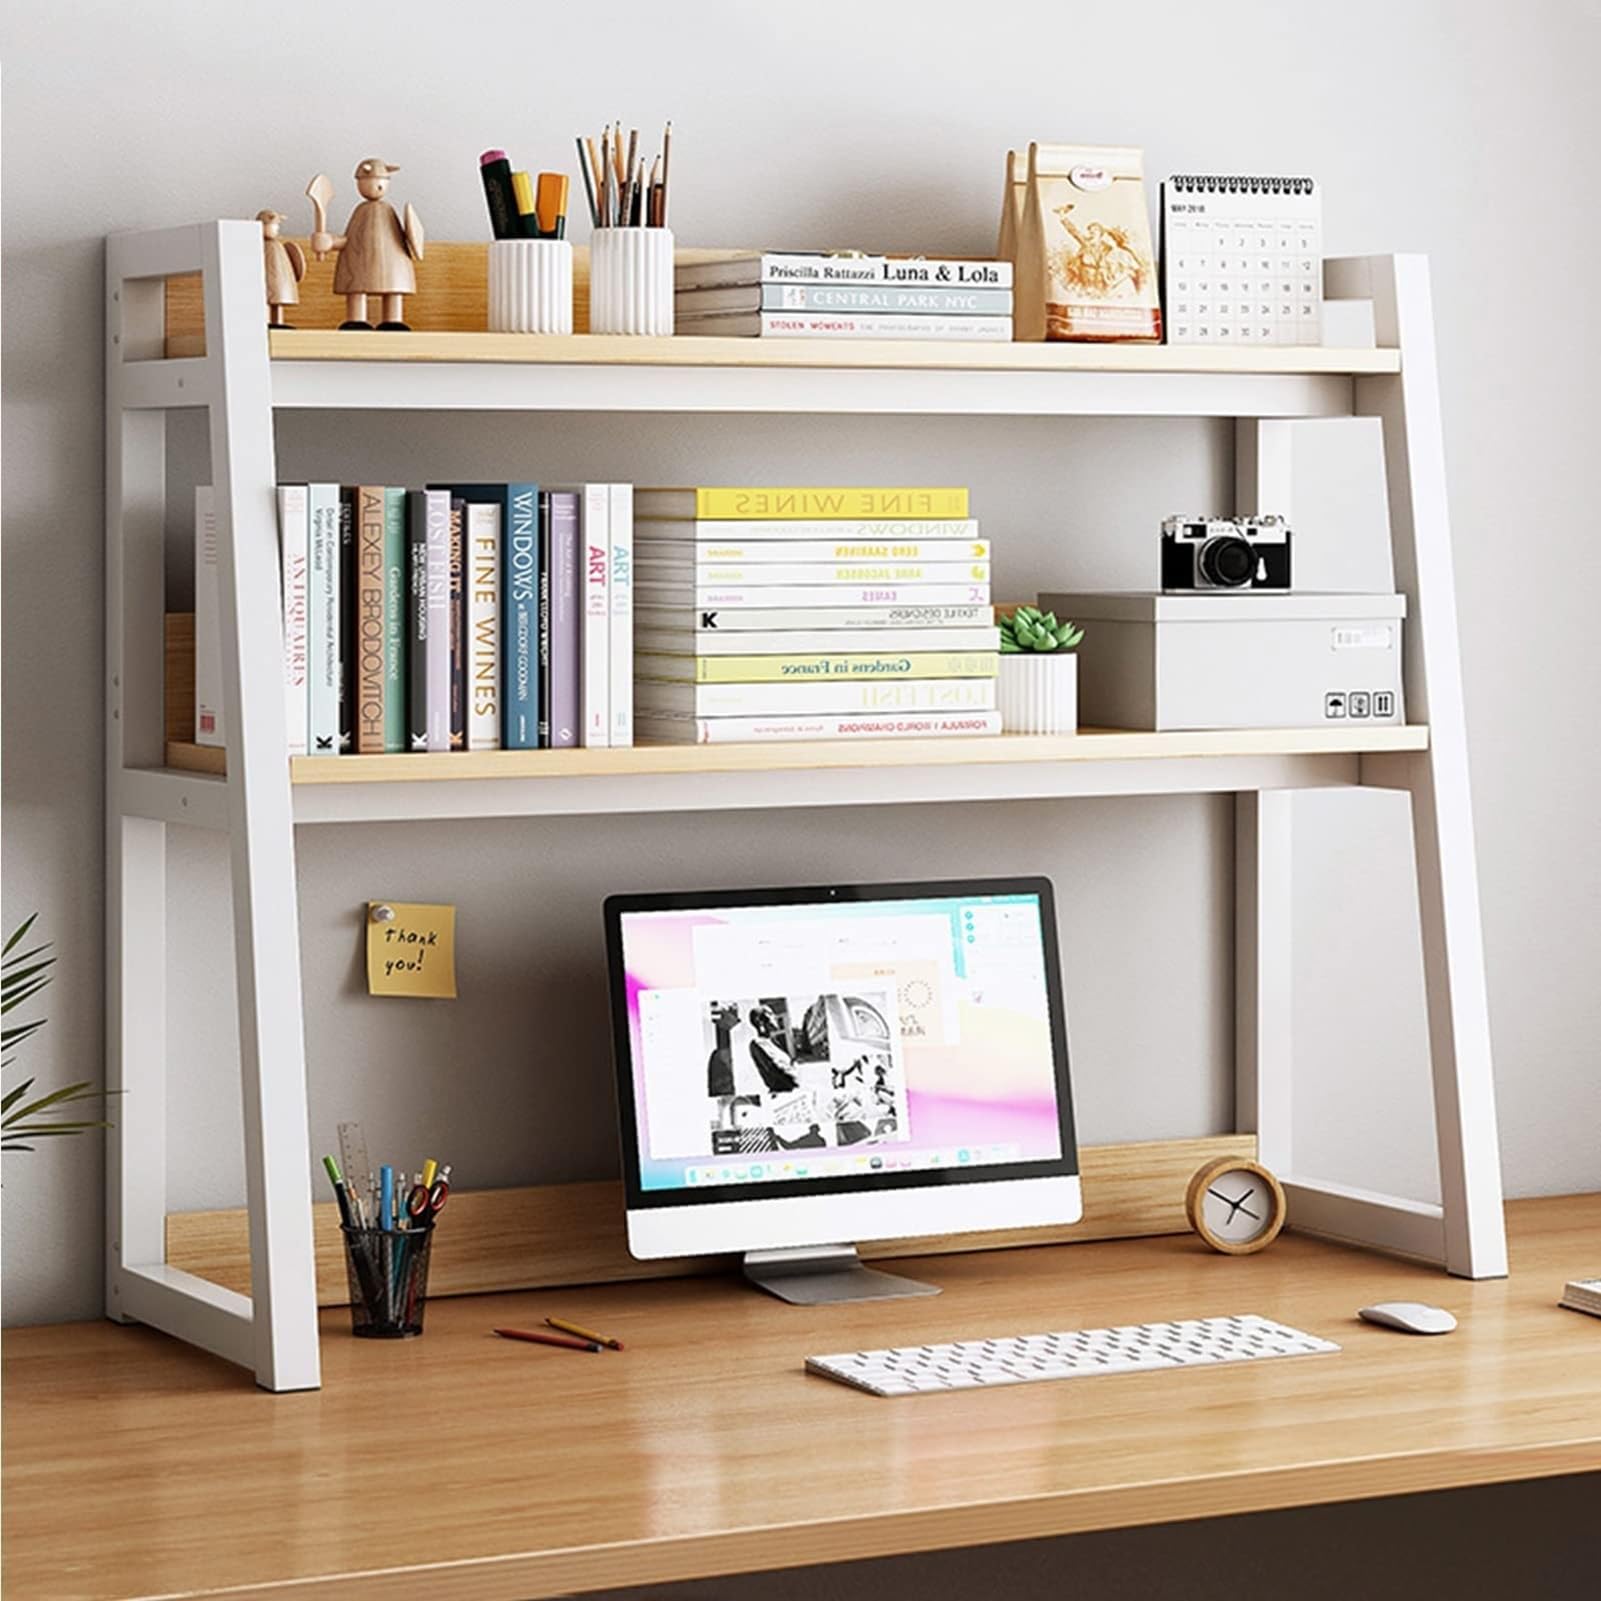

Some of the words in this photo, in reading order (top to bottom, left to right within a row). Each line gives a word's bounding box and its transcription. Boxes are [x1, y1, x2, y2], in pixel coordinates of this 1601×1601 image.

[769, 265, 820, 280] Priscilla
[823, 267, 876, 281] Rattazzi
[882, 263, 930, 281] Luna
[935, 266, 951, 282] &
[957, 266, 1000, 284] Lola
[813, 290, 889, 306] CENTRAL
[898, 292, 940, 308] PARK
[943, 293, 978, 309] NYC
[770, 321, 805, 330] STOLEN
[362, 492, 383, 582] ALEXEY
[450, 510, 463, 573] MAKING
[513, 491, 533, 601] WINDOWS
[450, 575, 463, 593] IT
[475, 538, 496, 604] FINE
[588, 545, 606, 587] ART
[613, 545, 630, 587] ART
[389, 566, 401, 619] Gardens
[289, 554, 305, 687] ANTIQUAIRES
[362, 588, 383, 737] BRODOVITCH
[389, 637, 400, 681] France
[475, 617, 496, 717] WINES
[385, 949, 424, 976] you!
